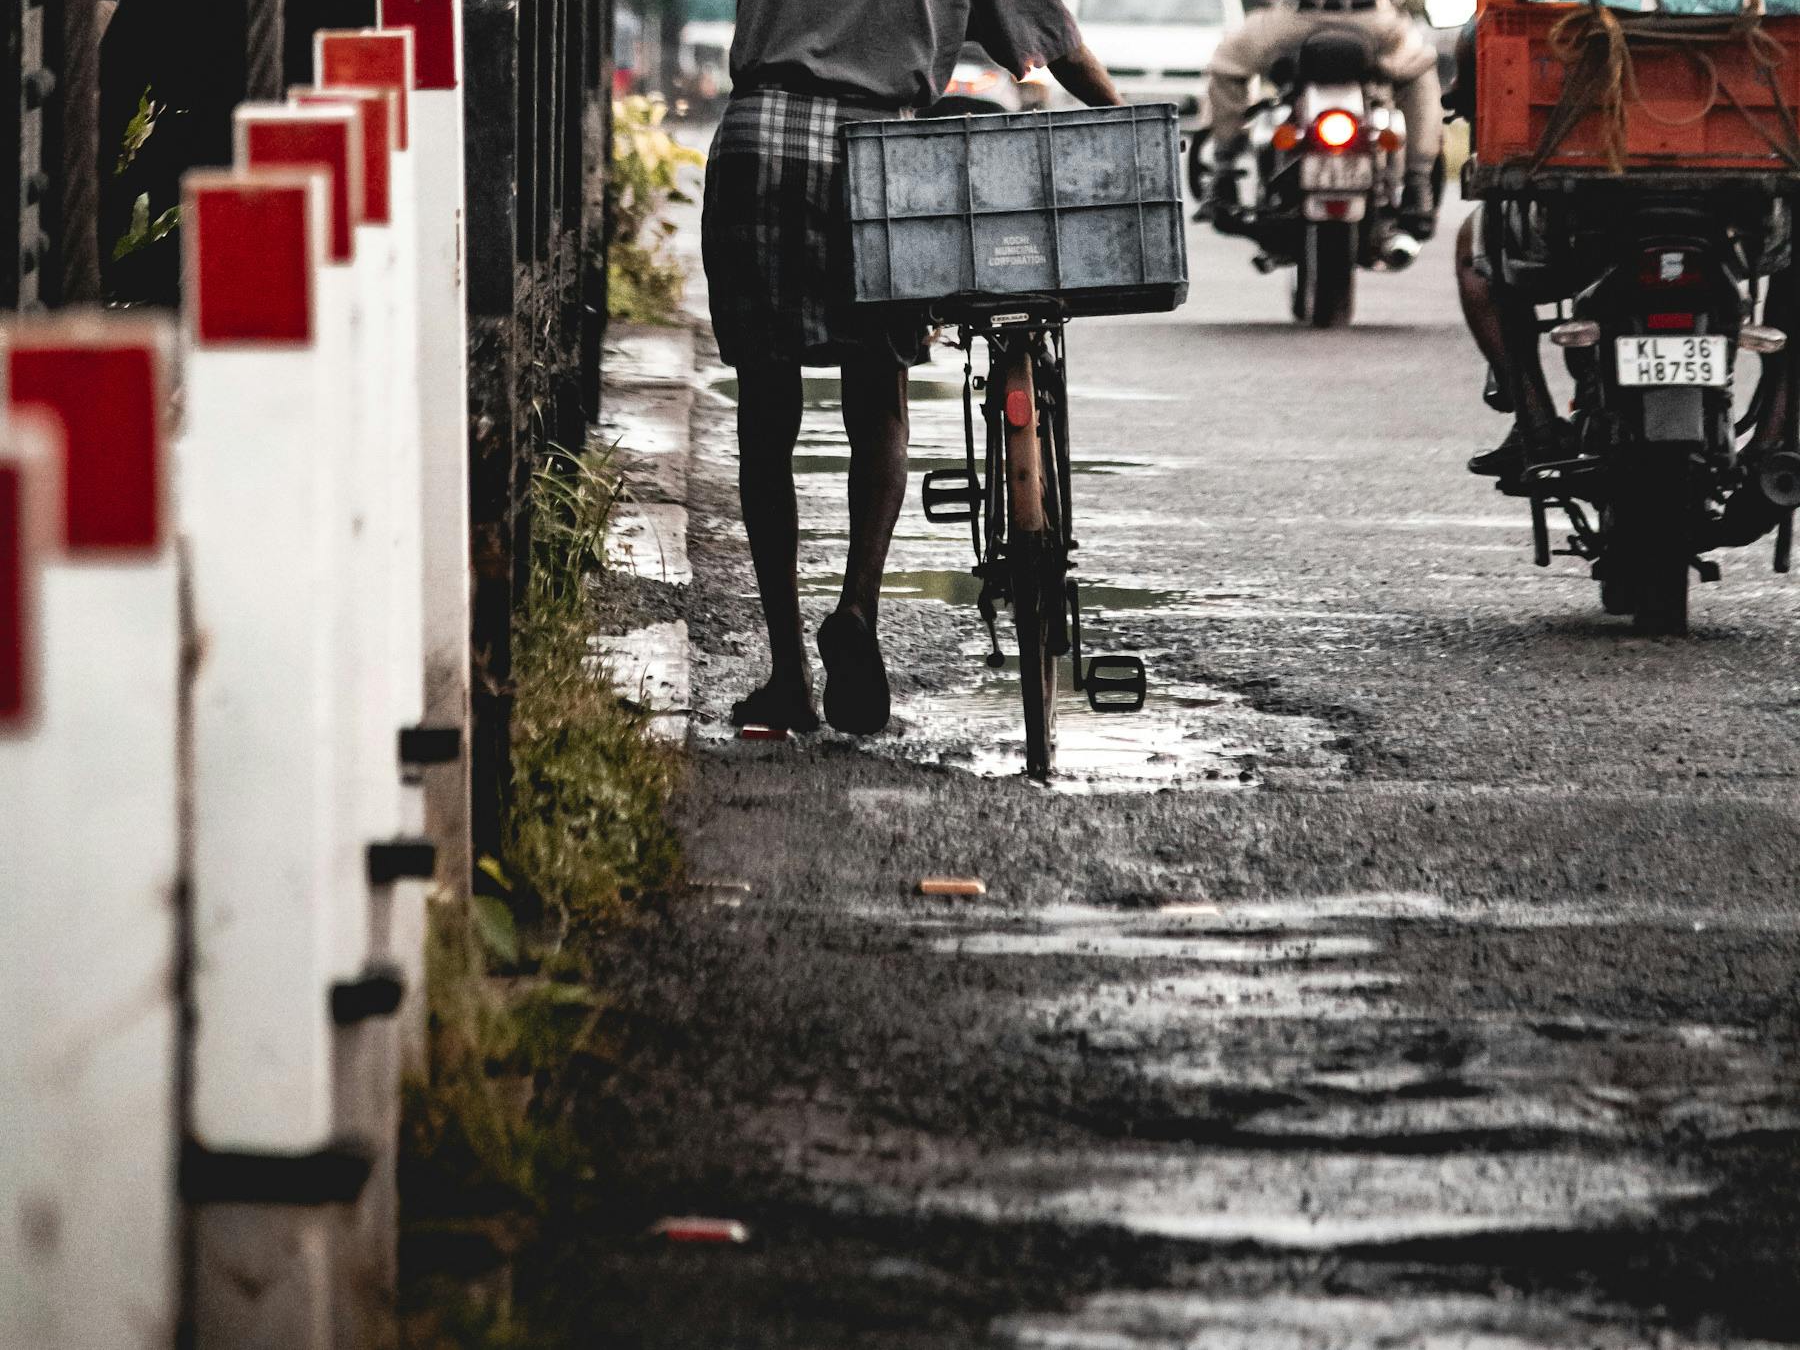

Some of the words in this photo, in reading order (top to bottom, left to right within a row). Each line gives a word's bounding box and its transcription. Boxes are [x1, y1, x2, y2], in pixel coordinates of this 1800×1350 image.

[994, 245, 1040, 256] MUNICIPAL
[989, 255, 1047, 266] CORPORATION
[1637, 338, 1666, 360] KL
[1683, 337, 1712, 359] 36
[1638, 361, 1713, 382] H8759
